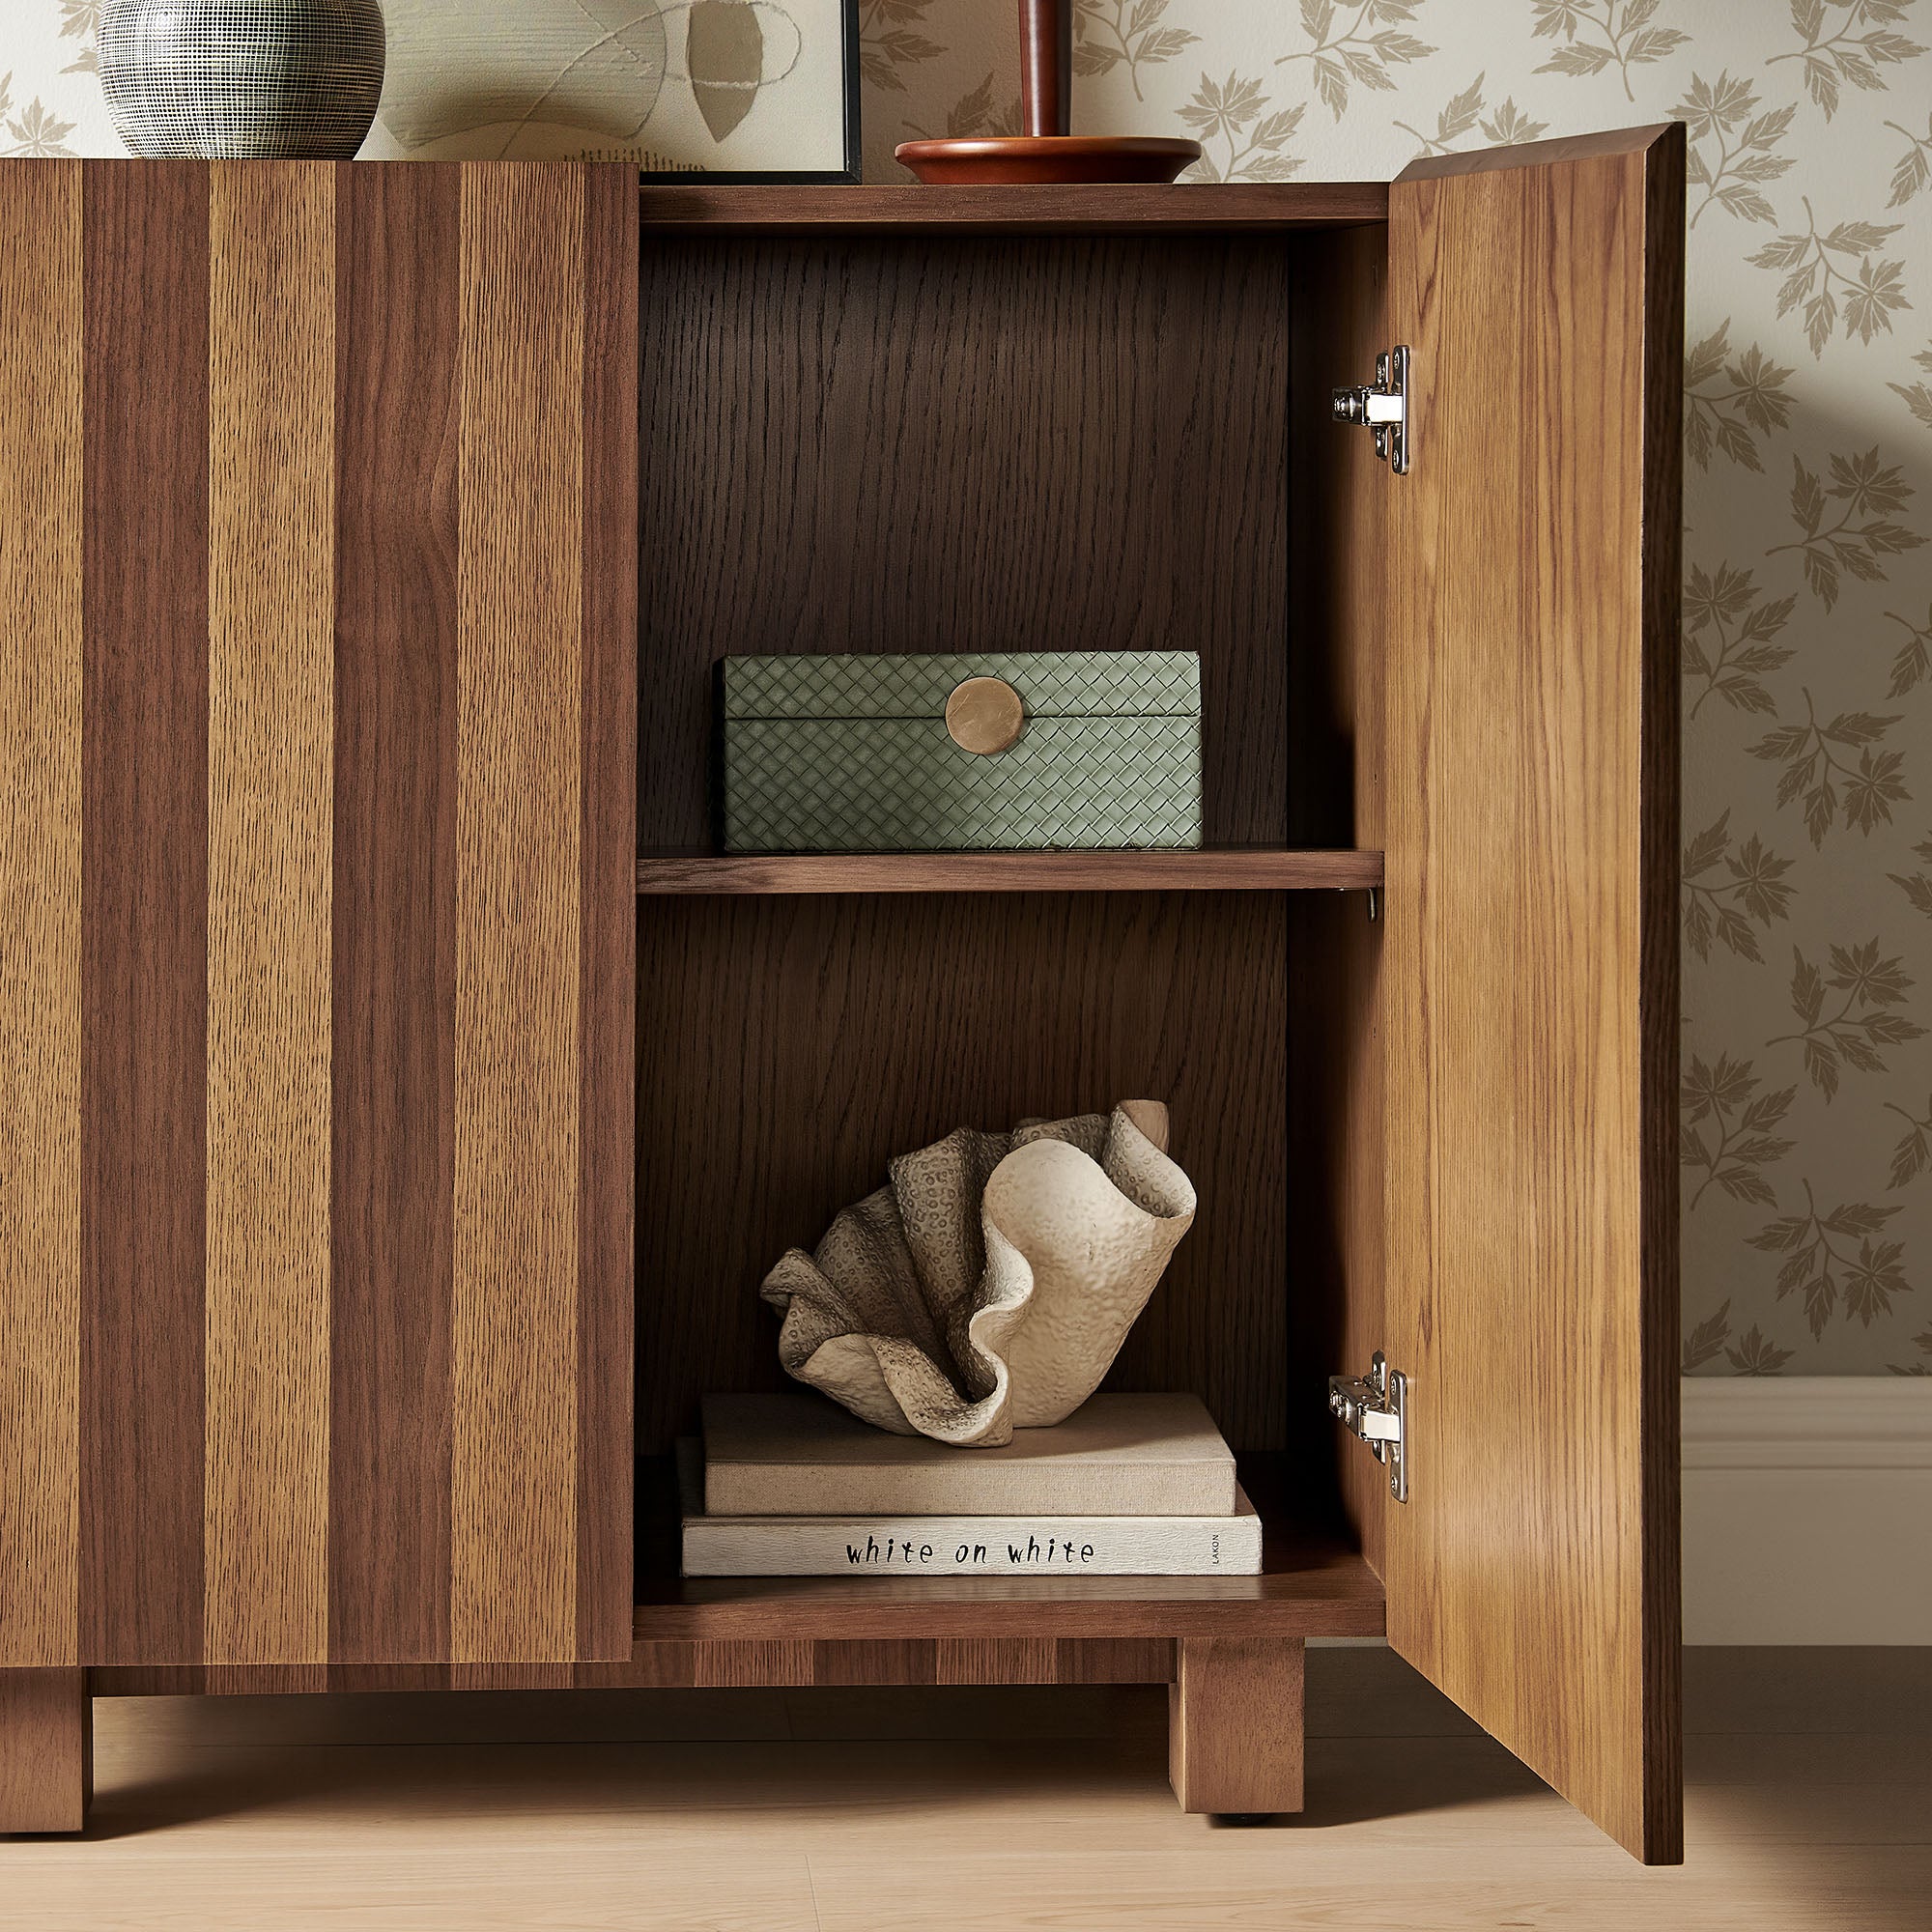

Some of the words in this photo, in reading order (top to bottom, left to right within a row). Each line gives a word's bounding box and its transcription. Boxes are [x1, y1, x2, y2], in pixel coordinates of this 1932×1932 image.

[845, 1535, 933, 1565] white
[954, 1544, 987, 1564] on
[1008, 1535, 1095, 1564] white
[1211, 1534, 1220, 1565] LAKON
